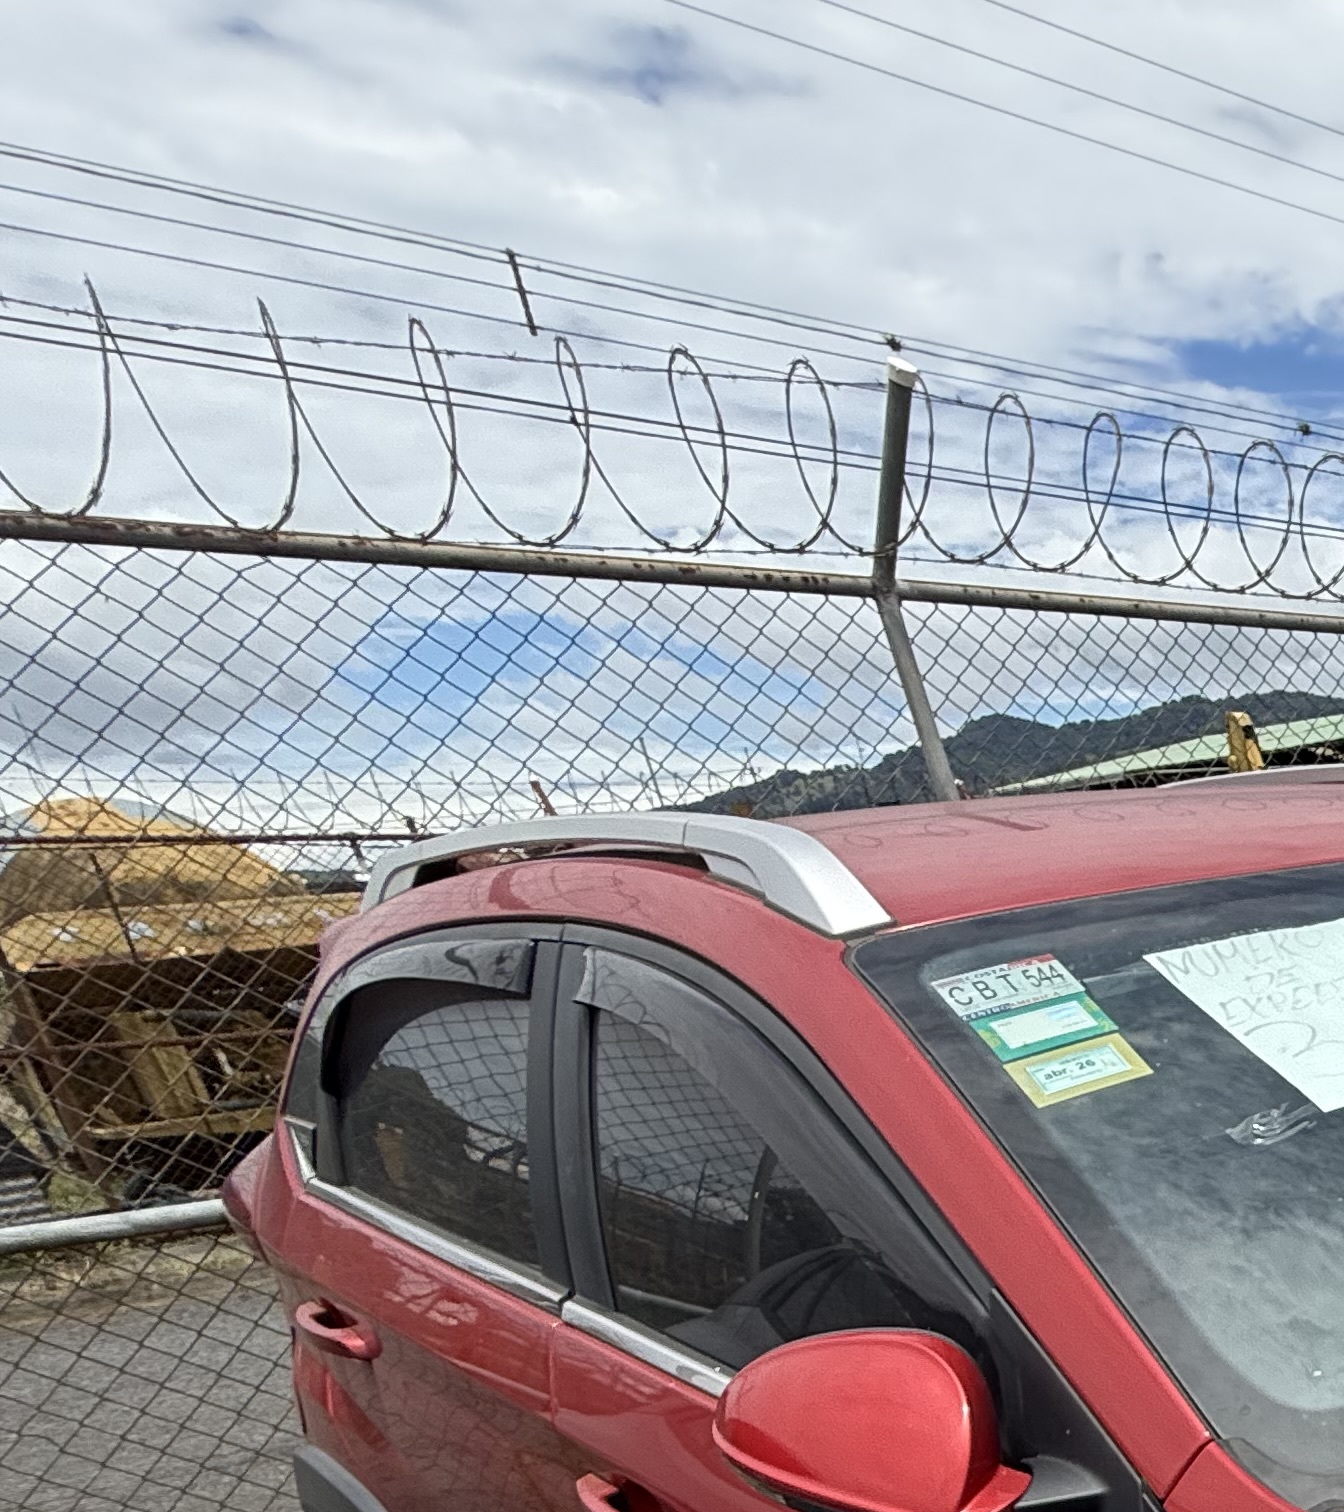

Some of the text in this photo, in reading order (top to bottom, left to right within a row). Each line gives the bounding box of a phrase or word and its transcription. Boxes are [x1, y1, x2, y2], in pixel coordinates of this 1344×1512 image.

[1156, 930, 1325, 984] NUMERO
[948, 964, 1066, 1006] CBT 544
[1244, 964, 1299, 995] DE
[1043, 1067, 1075, 1081] abr.
[1075, 1059, 1096, 1071] 26
